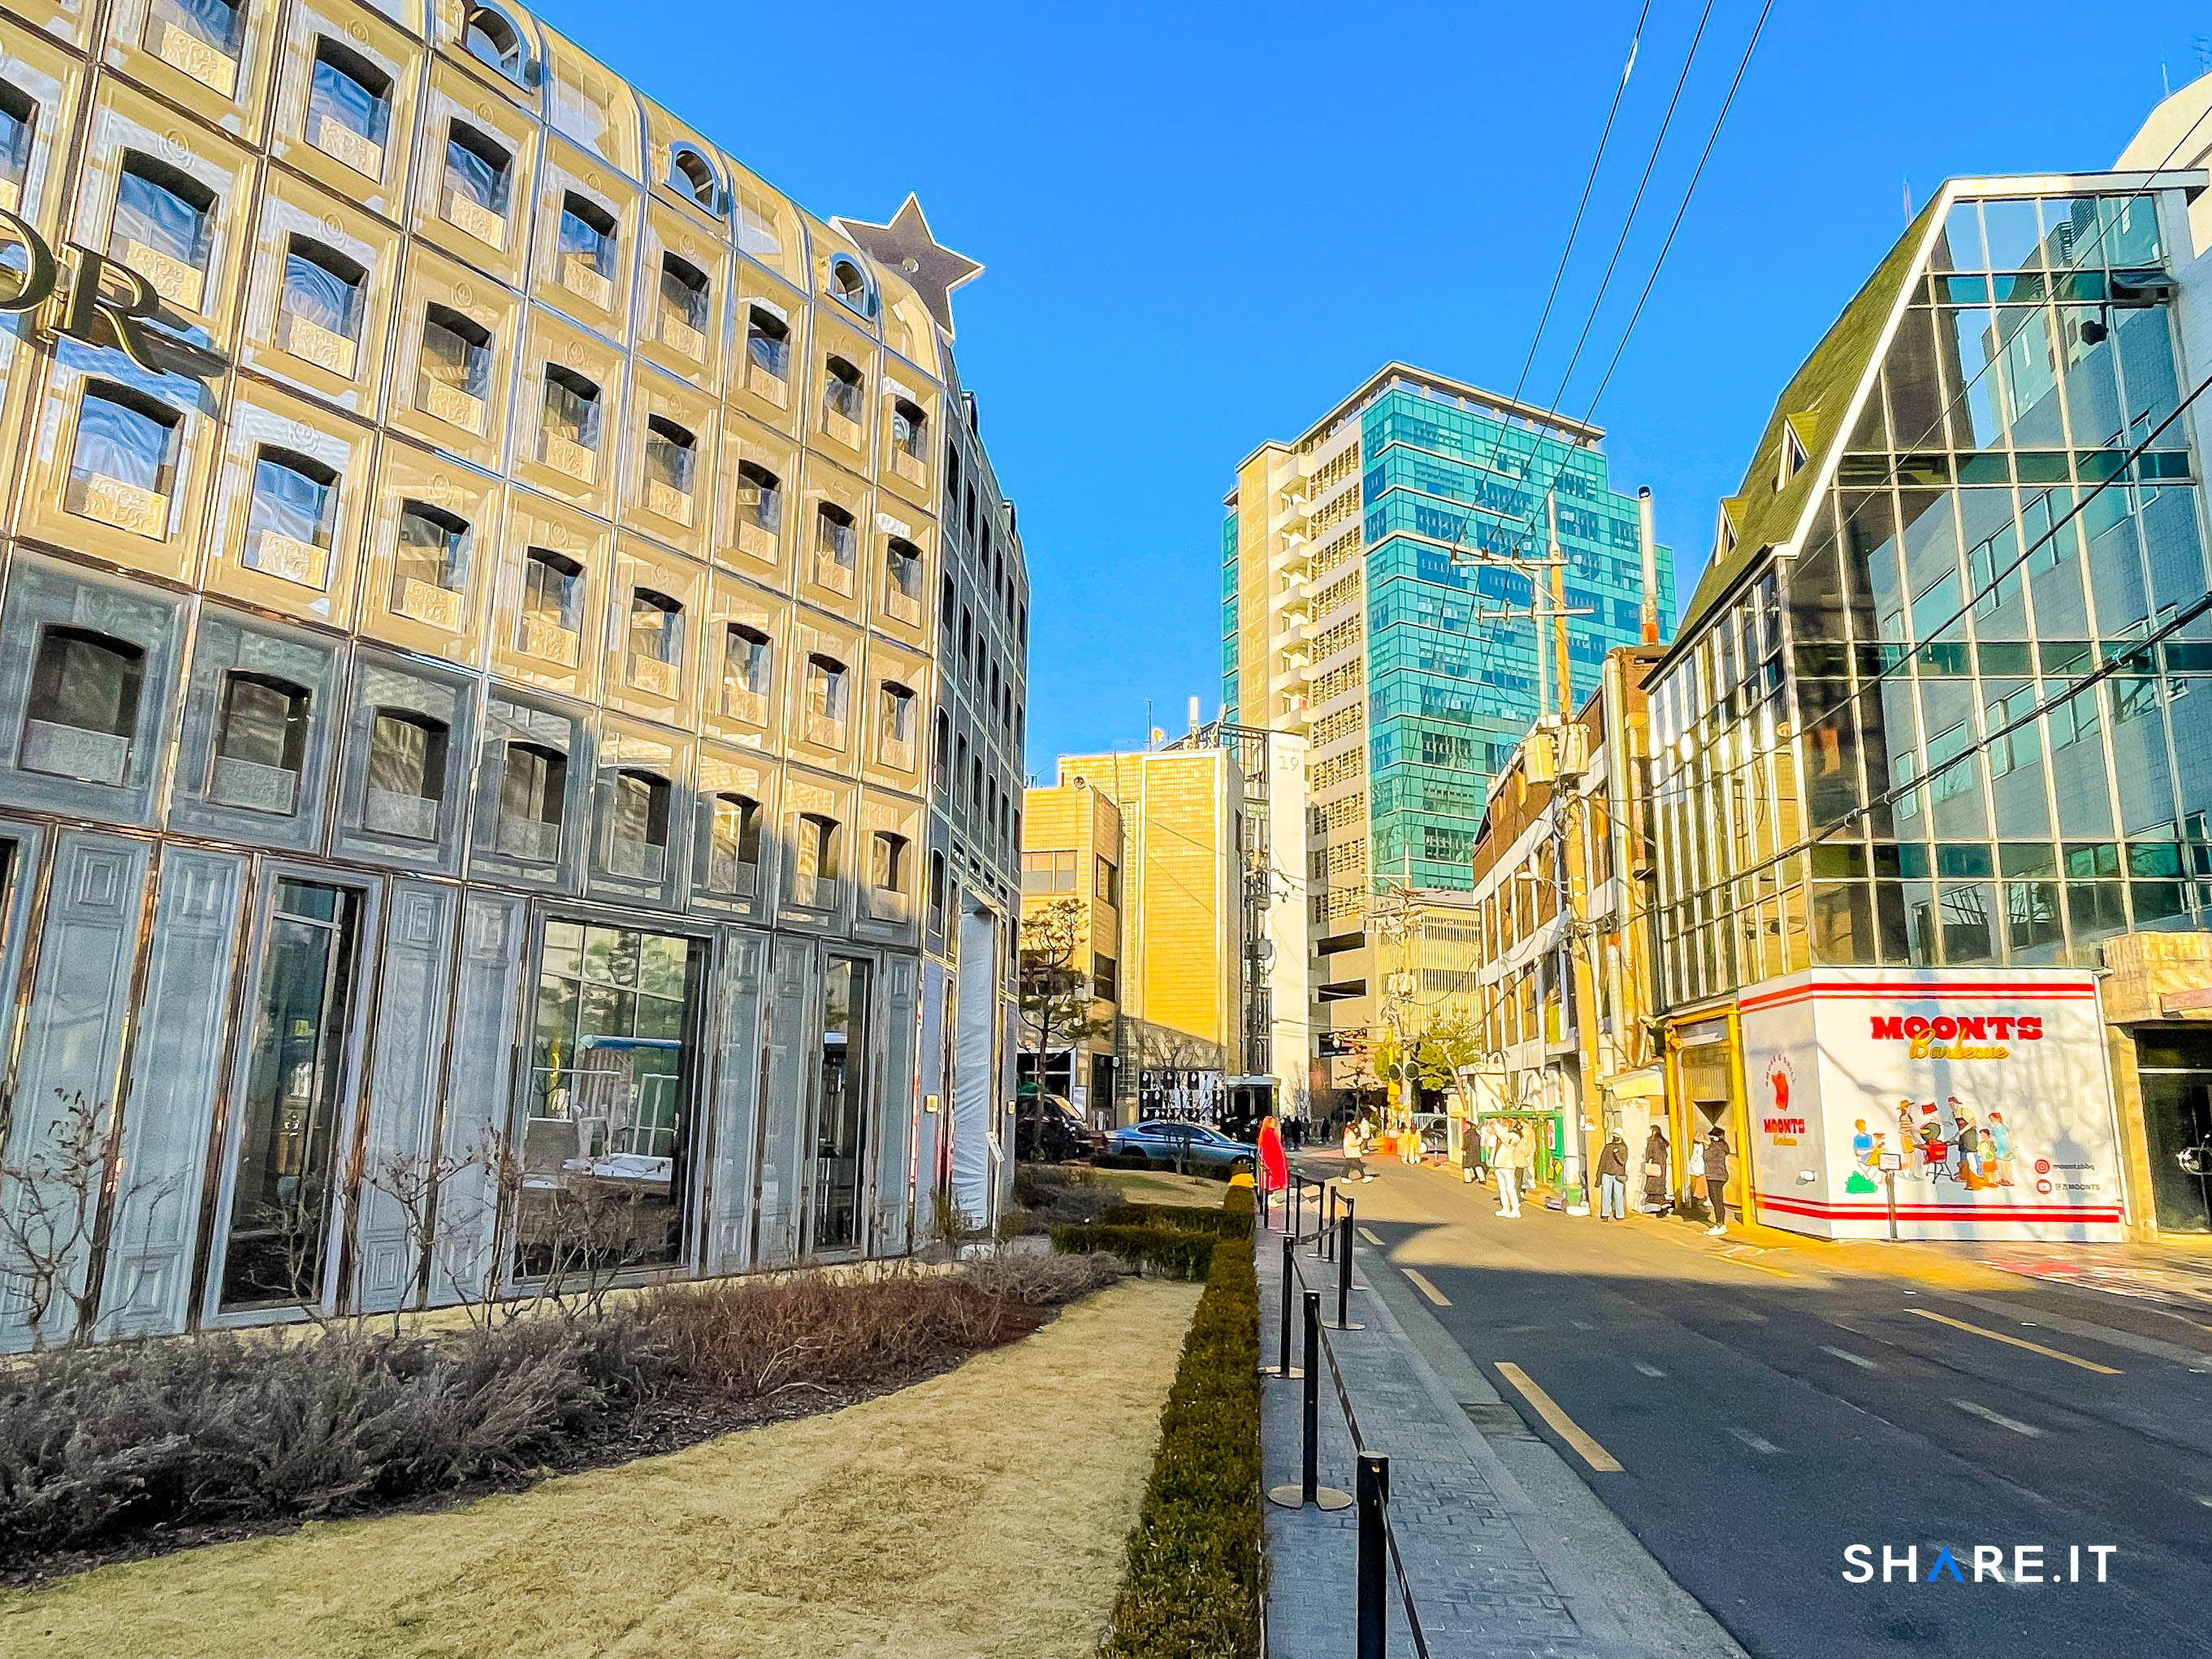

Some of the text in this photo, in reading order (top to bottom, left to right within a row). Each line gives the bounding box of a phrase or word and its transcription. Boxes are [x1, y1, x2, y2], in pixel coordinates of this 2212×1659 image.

[1870, 1016, 2043, 1040] MOONTS
[1910, 1027, 2009, 1059] Barbecue
[1764, 1118, 1805, 1134] MOONTS
